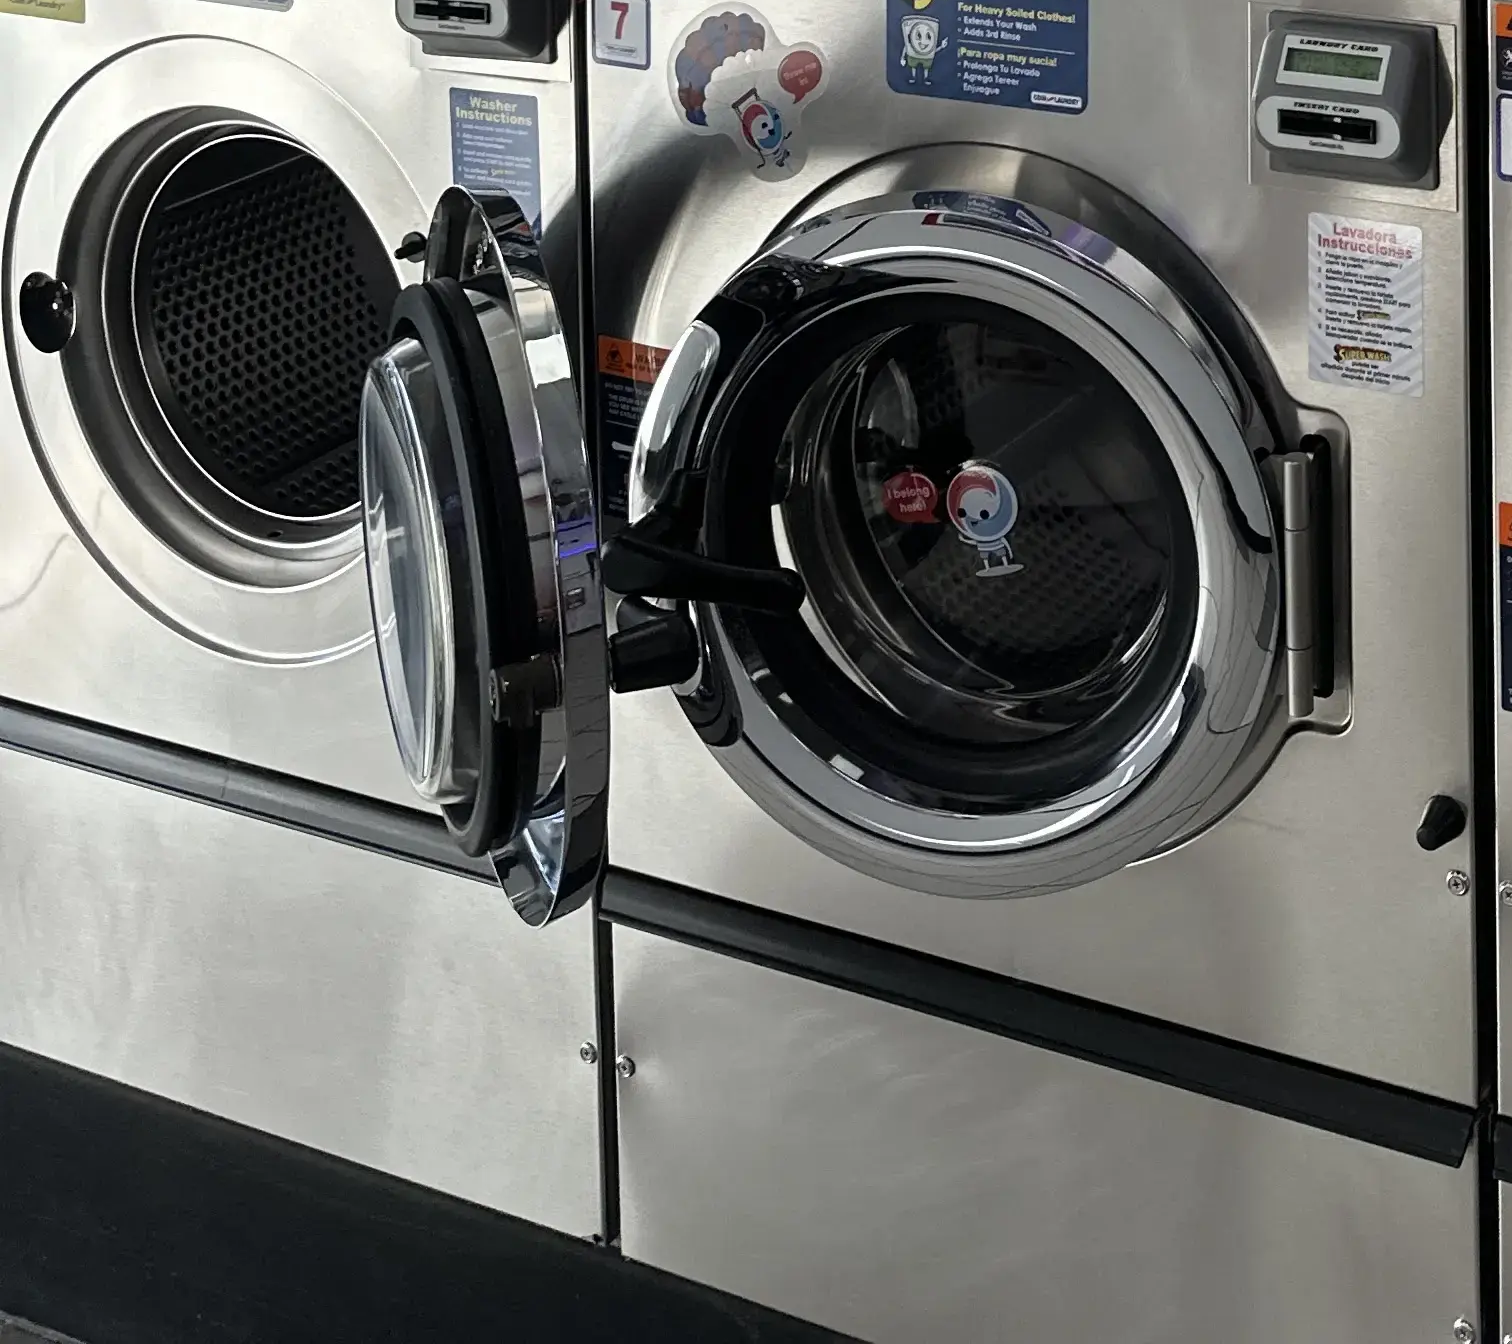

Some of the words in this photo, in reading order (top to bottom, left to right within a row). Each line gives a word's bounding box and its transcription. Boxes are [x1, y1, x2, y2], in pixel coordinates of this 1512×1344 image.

[610, 0, 630, 41] 7
[957, 1, 973, 13] For
[974, 4, 1004, 18] Heavy
[1036, 10, 1076, 24] Clothes!
[963, 16, 994, 28] Extends
[995, 19, 1014, 29] Your
[1015, 21, 1038, 32] Wash
[963, 27, 985, 38] Adds
[985, 29, 999, 39] 3rd
[1000, 31, 1021, 42] Rinse
[983, 52, 1005, 65] ropa
[1006, 54, 1028, 66] muy
[963, 60, 999, 74] Prolonga
[999, 63, 1009, 74] Tu
[1010, 66, 1041, 78] Lavado
[963, 71, 994, 84] Agrega
[469, 96, 518, 113] Washer
[455, 106, 533, 127] Instructions
[1333, 222, 1398, 245] Lavadora
[1317, 233, 1413, 260] Instrucciones
[1338, 348, 1367, 363] SUPER
[893, 486, 930, 499] belong
